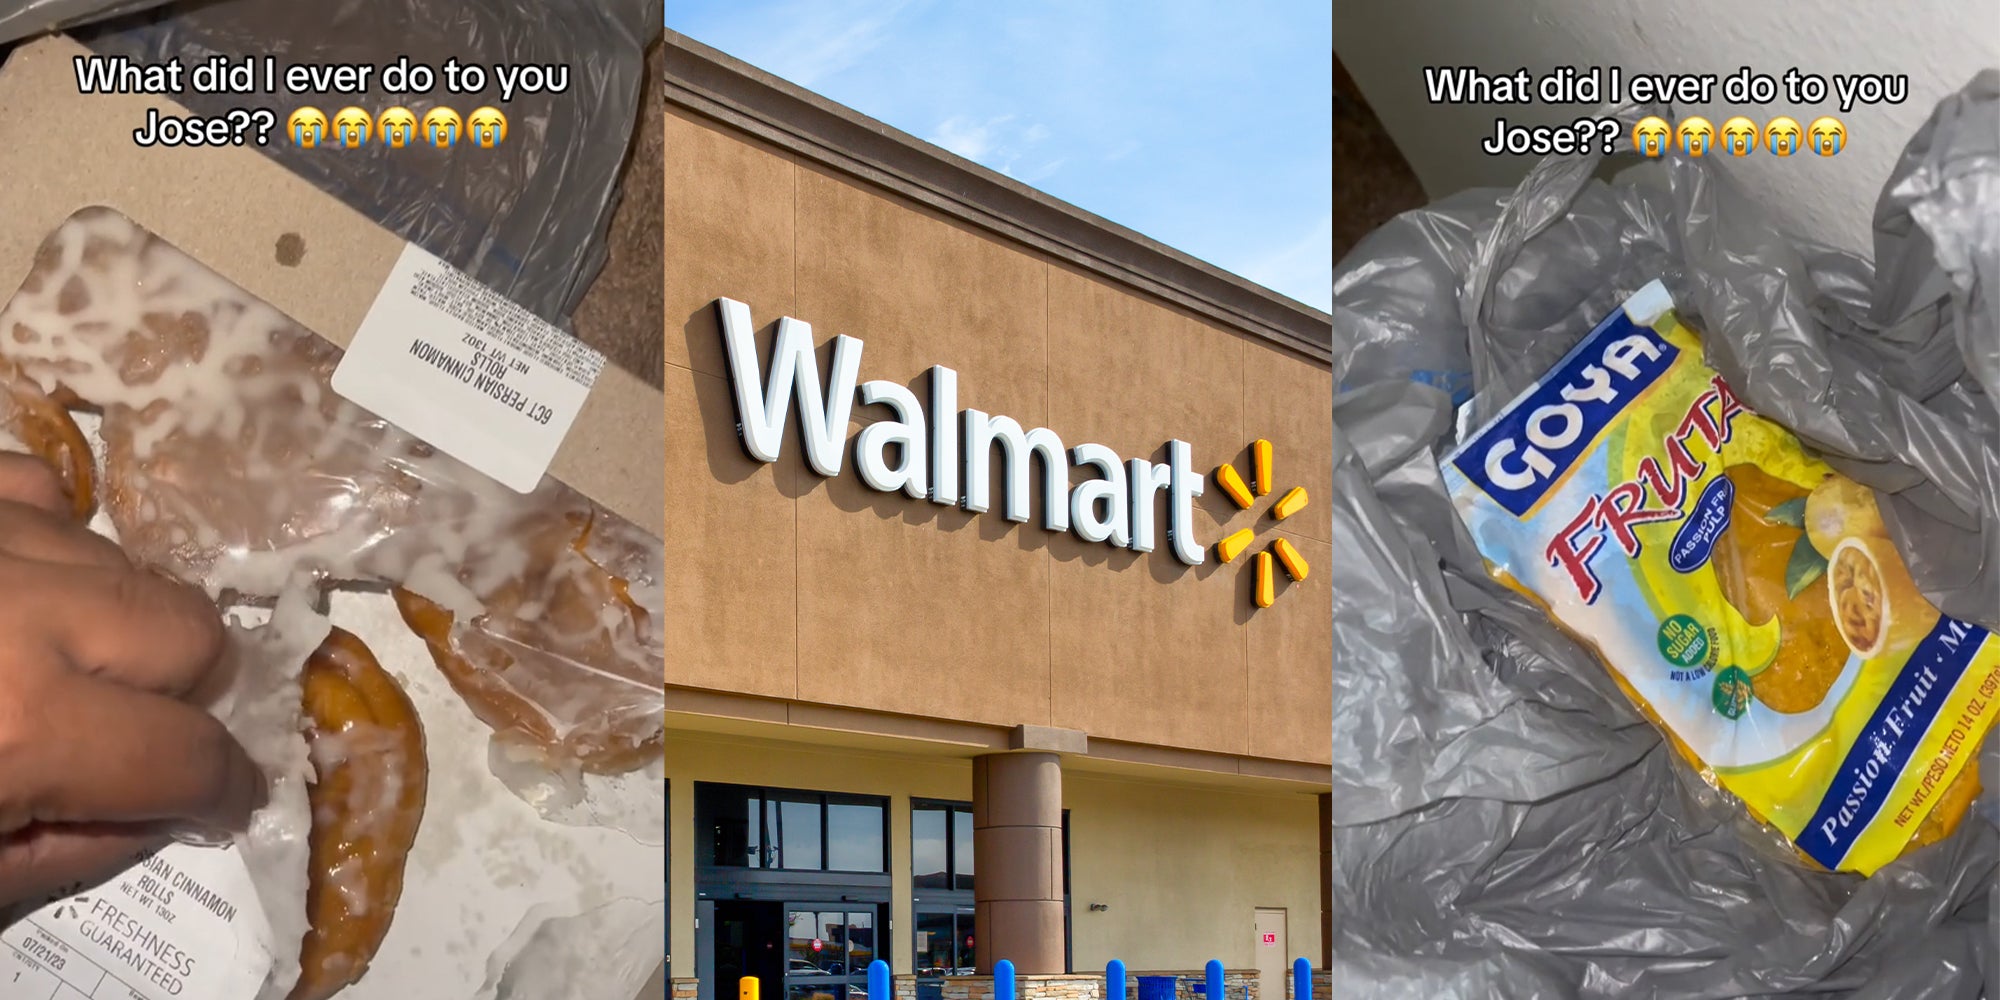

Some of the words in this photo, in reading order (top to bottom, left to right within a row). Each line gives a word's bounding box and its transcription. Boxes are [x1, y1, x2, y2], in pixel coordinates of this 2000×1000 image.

[409, 338, 476, 385] CINNAMON
[470, 350, 508, 380] ROLLS
[488, 347, 508, 365] WT
[511, 357, 530, 376] NET
[474, 374, 528, 412] PERSIAN
[526, 402, 553, 425] 6CT
[717, 296, 1205, 566] Walmart
[1484, 333, 1663, 492] GOYA
[1545, 373, 1757, 605] FRUTA
[1674, 508, 1713, 564] PASSION
[1711, 485, 1729, 507] FR
[1703, 505, 1726, 544] PULP
[1662, 619, 1683, 640] NO
[1666, 622, 1700, 659] SUGAR
[1681, 636, 1705, 664] ADDED
[1670, 671, 1685, 682] NOT
[1690, 666, 1707, 681] LOW
[1820, 736, 1891, 846] Passion
[1883, 664, 1938, 740] Fruit
[1893, 801, 1918, 828] NET
[1943, 727, 1966, 762] NETO
[1957, 710, 1976, 733] 14
[1970, 694, 1988, 718] OZ.
[119, 881, 140, 900] NET
[138, 895, 155, 909] WT
[136, 874, 175, 906] ROLLS
[140, 854, 174, 881] SIAN
[171, 871, 238, 924] CINNAMON
[21, 936, 67, 972] 07/21/23
[90, 896, 196, 978] FRESHNESS
[79, 920, 184, 996] GUARANTEED
[12, 971, 22, 984] 1
